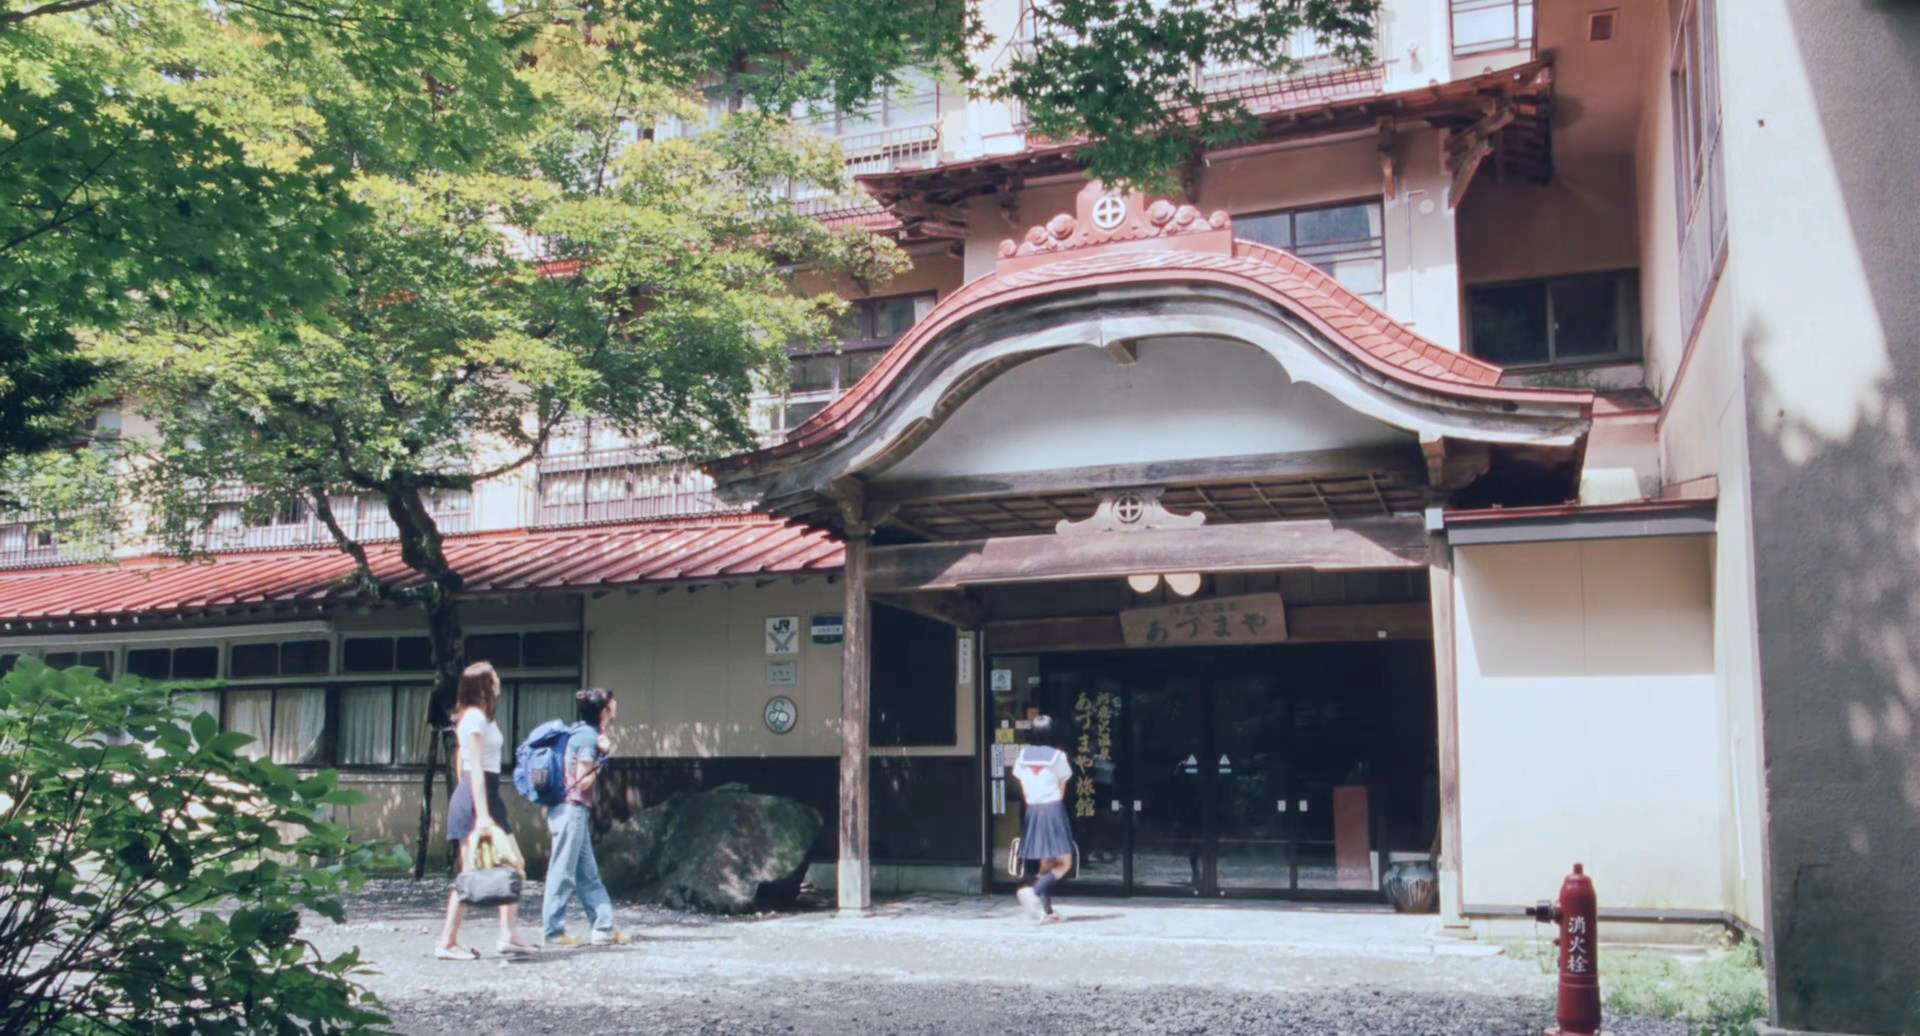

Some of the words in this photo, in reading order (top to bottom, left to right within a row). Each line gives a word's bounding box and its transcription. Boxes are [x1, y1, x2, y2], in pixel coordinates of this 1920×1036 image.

[772, 619, 790, 631] JR
[1146, 613, 1267, 642] あづまや
[1074, 692, 1096, 818] あづまや旅館
[1567, 915, 1589, 974] 消火栓
